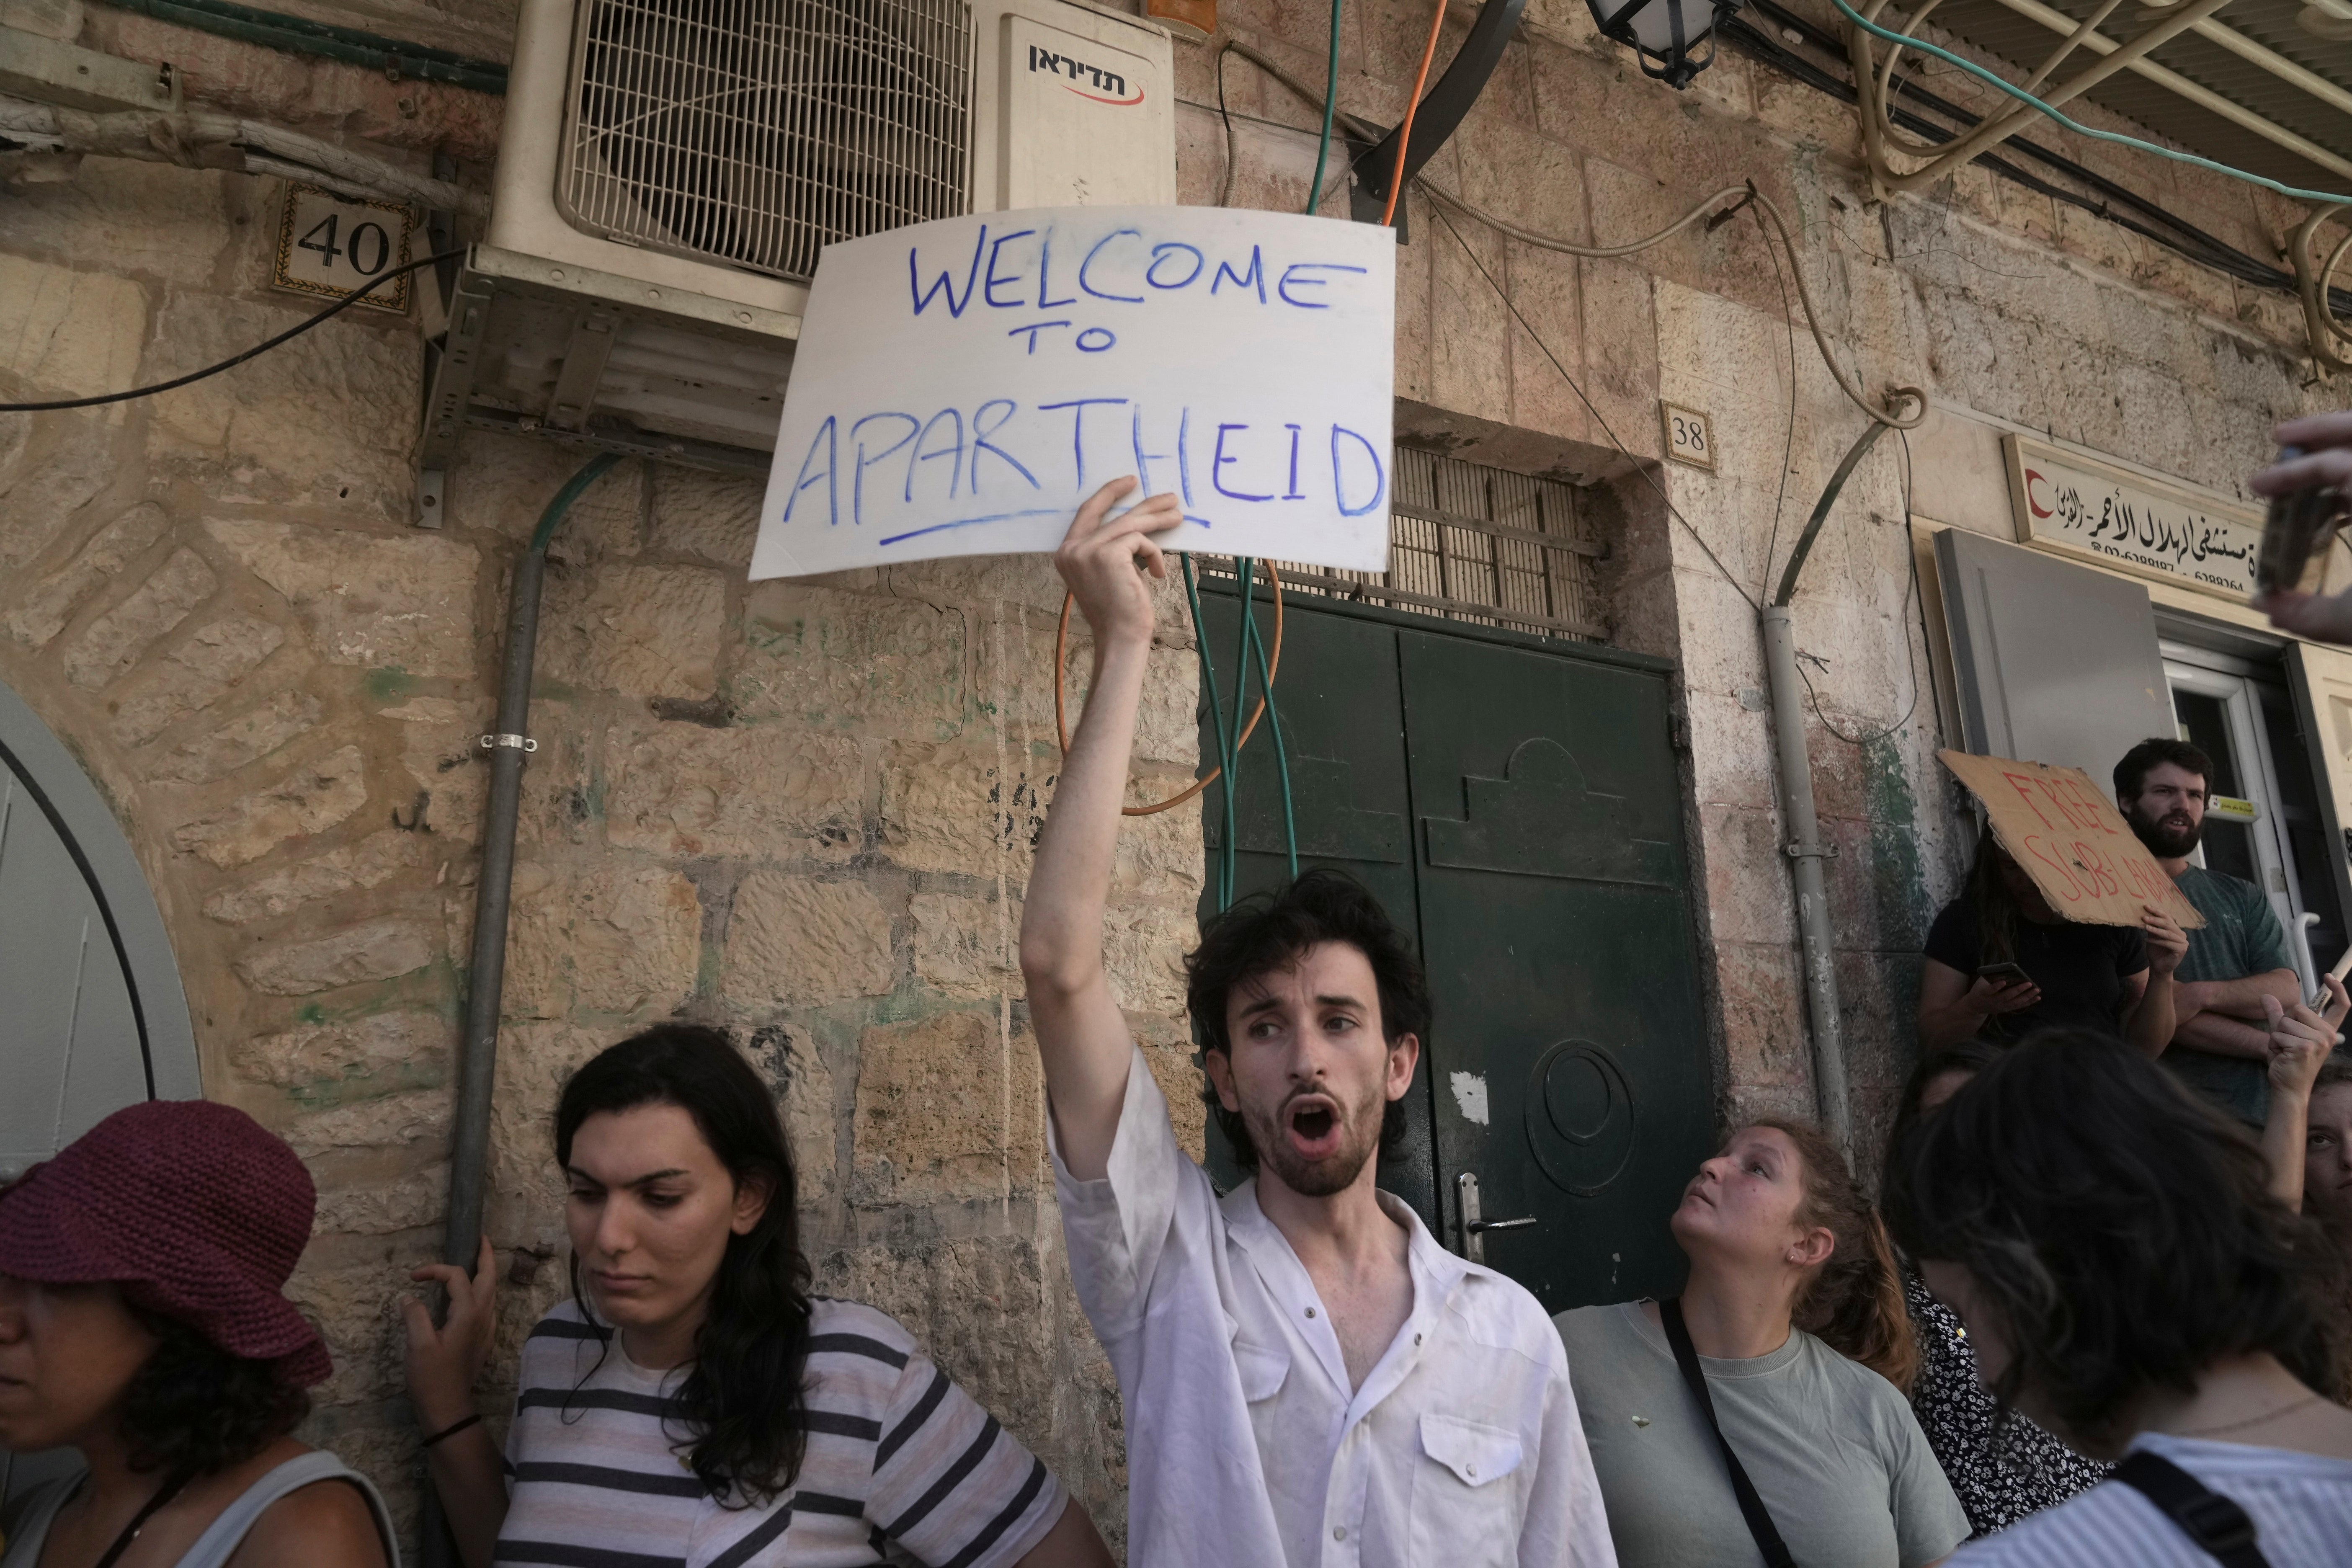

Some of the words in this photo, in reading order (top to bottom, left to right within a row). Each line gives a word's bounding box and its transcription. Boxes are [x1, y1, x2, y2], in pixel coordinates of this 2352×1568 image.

[1029, 45, 1125, 96] תדיראן
[298, 214, 389, 276] 40
[909, 224, 1367, 318] WELCOME
[1008, 321, 1117, 355] TO
[783, 398, 1385, 526] APARTHEID
[1673, 417, 1704, 451] 38
[2002, 771, 2118, 835] FREE
